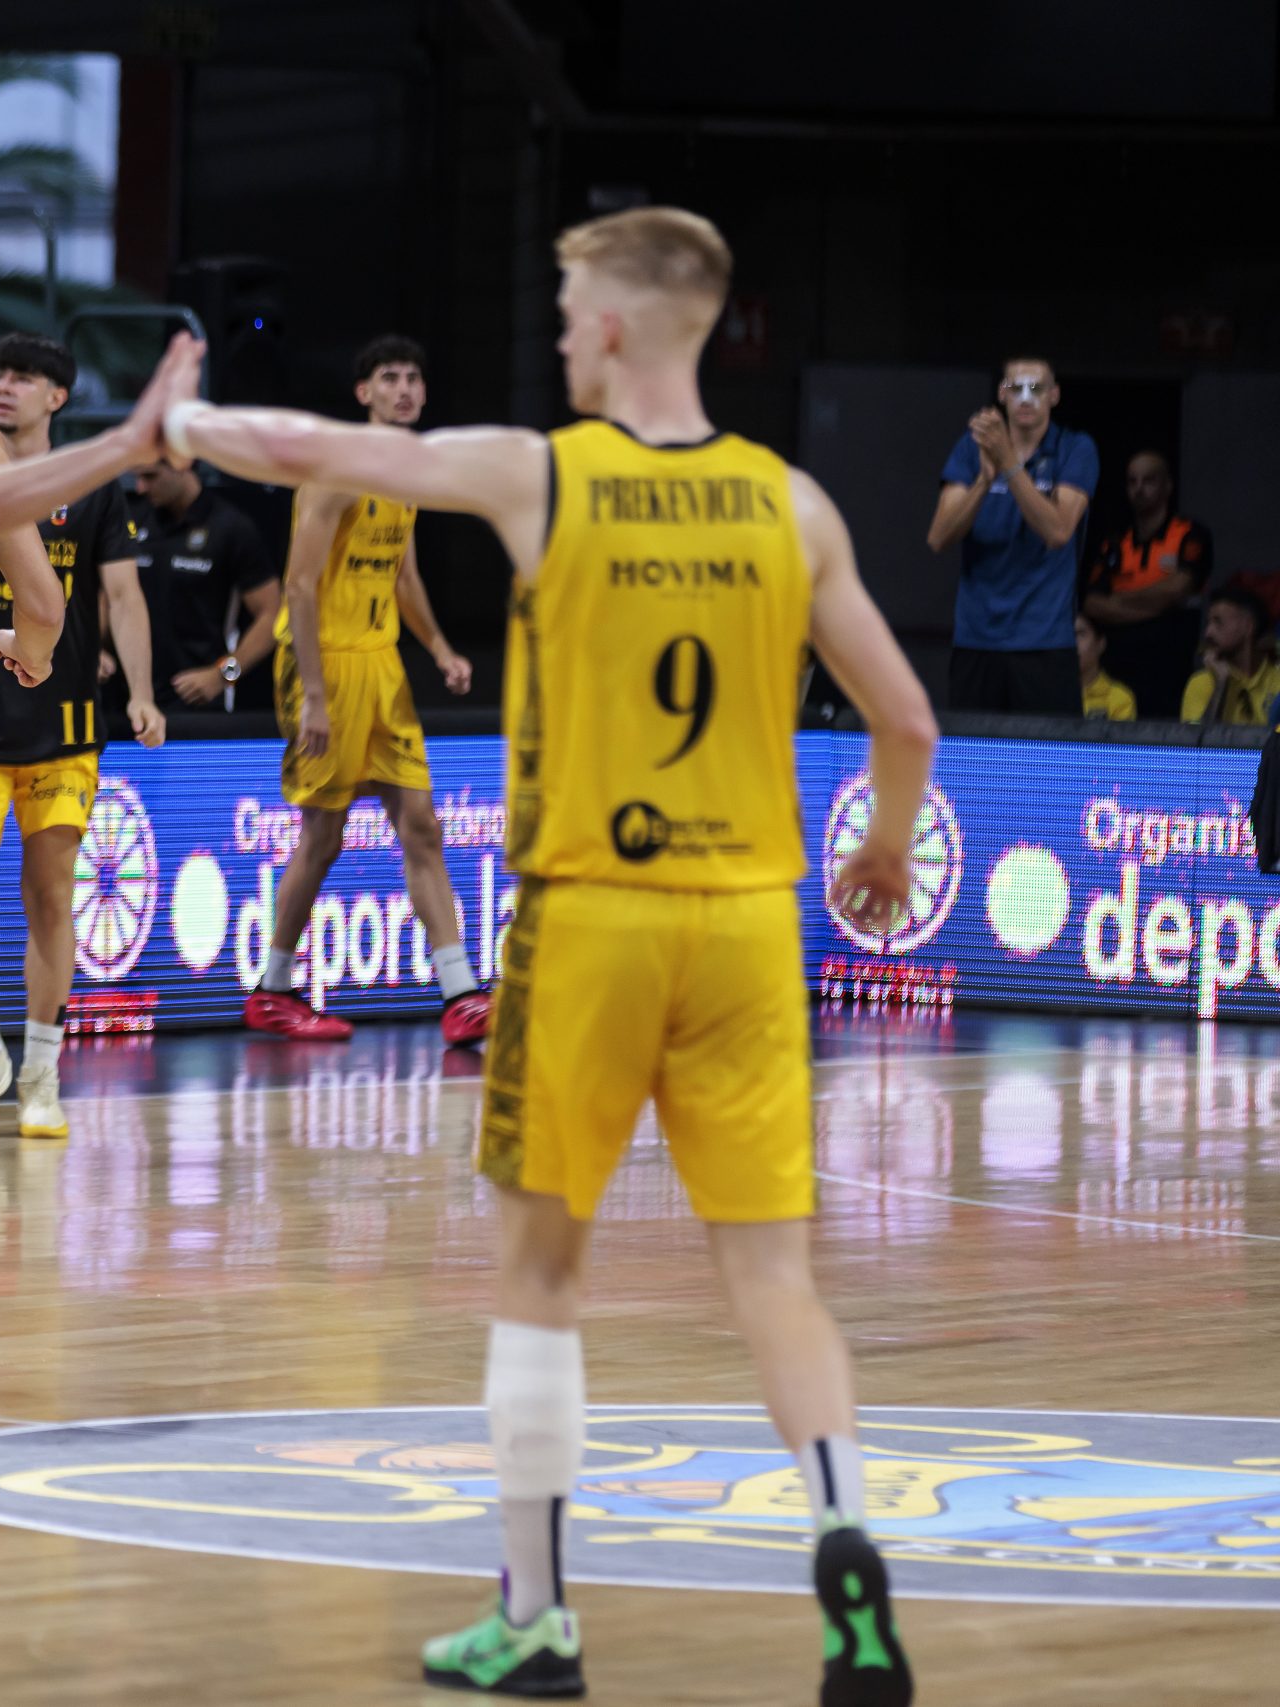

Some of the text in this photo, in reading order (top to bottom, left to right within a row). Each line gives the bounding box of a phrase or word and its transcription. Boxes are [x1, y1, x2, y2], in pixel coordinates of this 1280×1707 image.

[609, 559, 761, 590] HOVIMA
[60, 700, 96, 746] 11
[654, 633, 716, 770] 9
